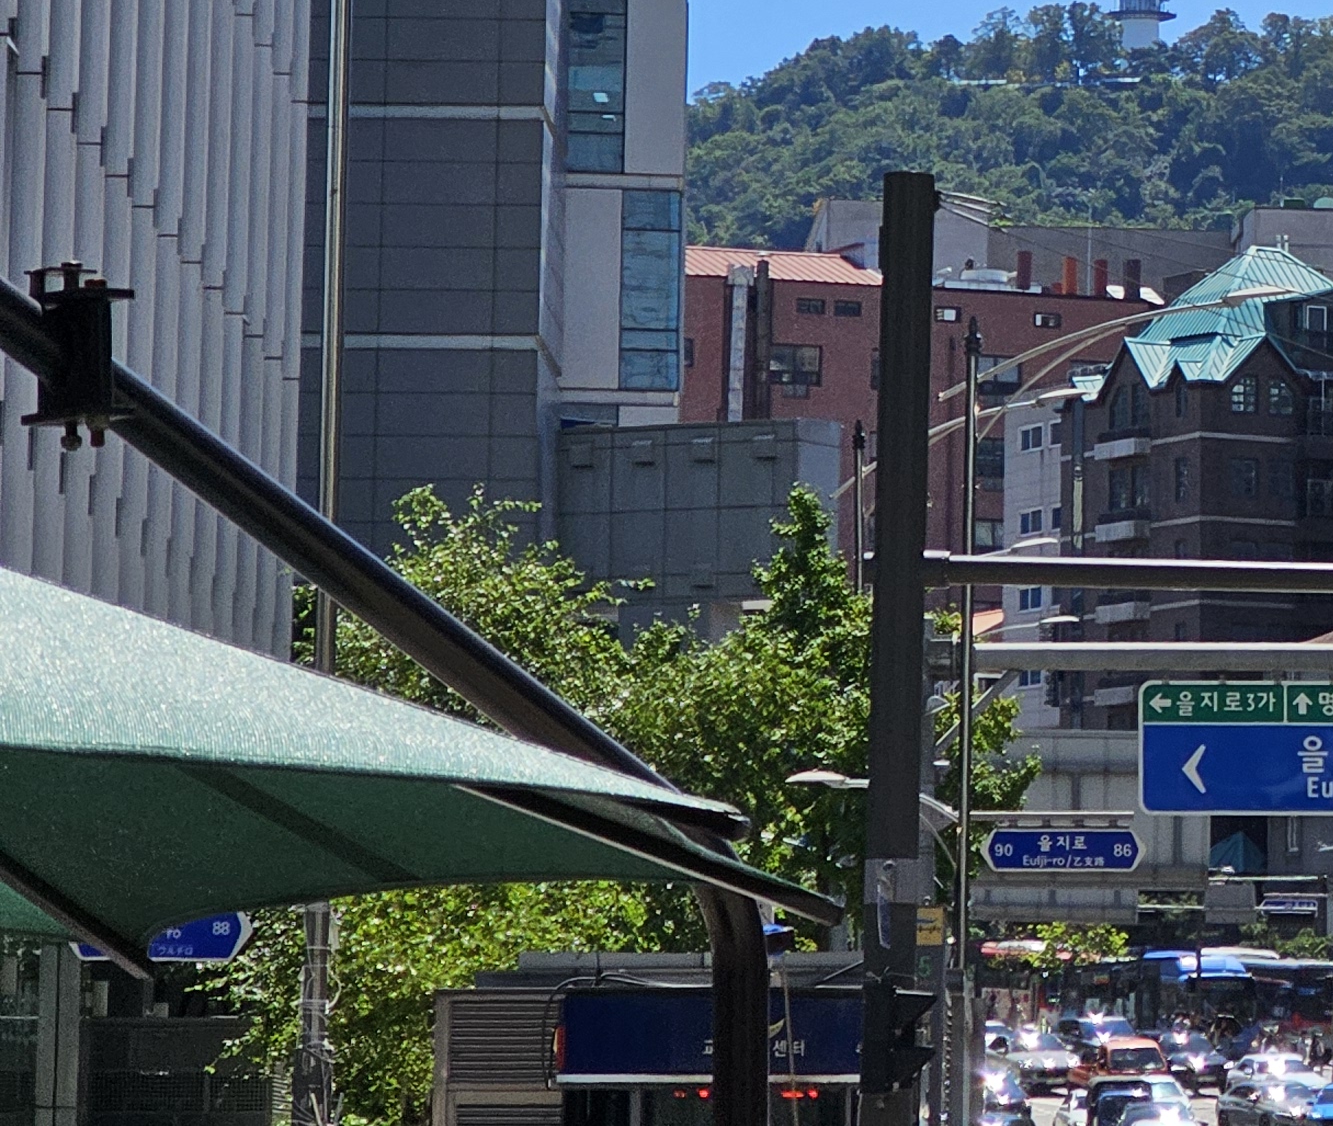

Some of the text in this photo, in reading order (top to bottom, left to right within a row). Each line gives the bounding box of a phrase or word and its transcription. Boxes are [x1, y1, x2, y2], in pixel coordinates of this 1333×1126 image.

[1176, 691, 1277, 716] 을지로3가
[994, 844, 1013, 857] 90
[1037, 835, 1088, 852] 을지로
[1113, 844, 1132, 857] 86
[212, 921, 231, 936] 88
